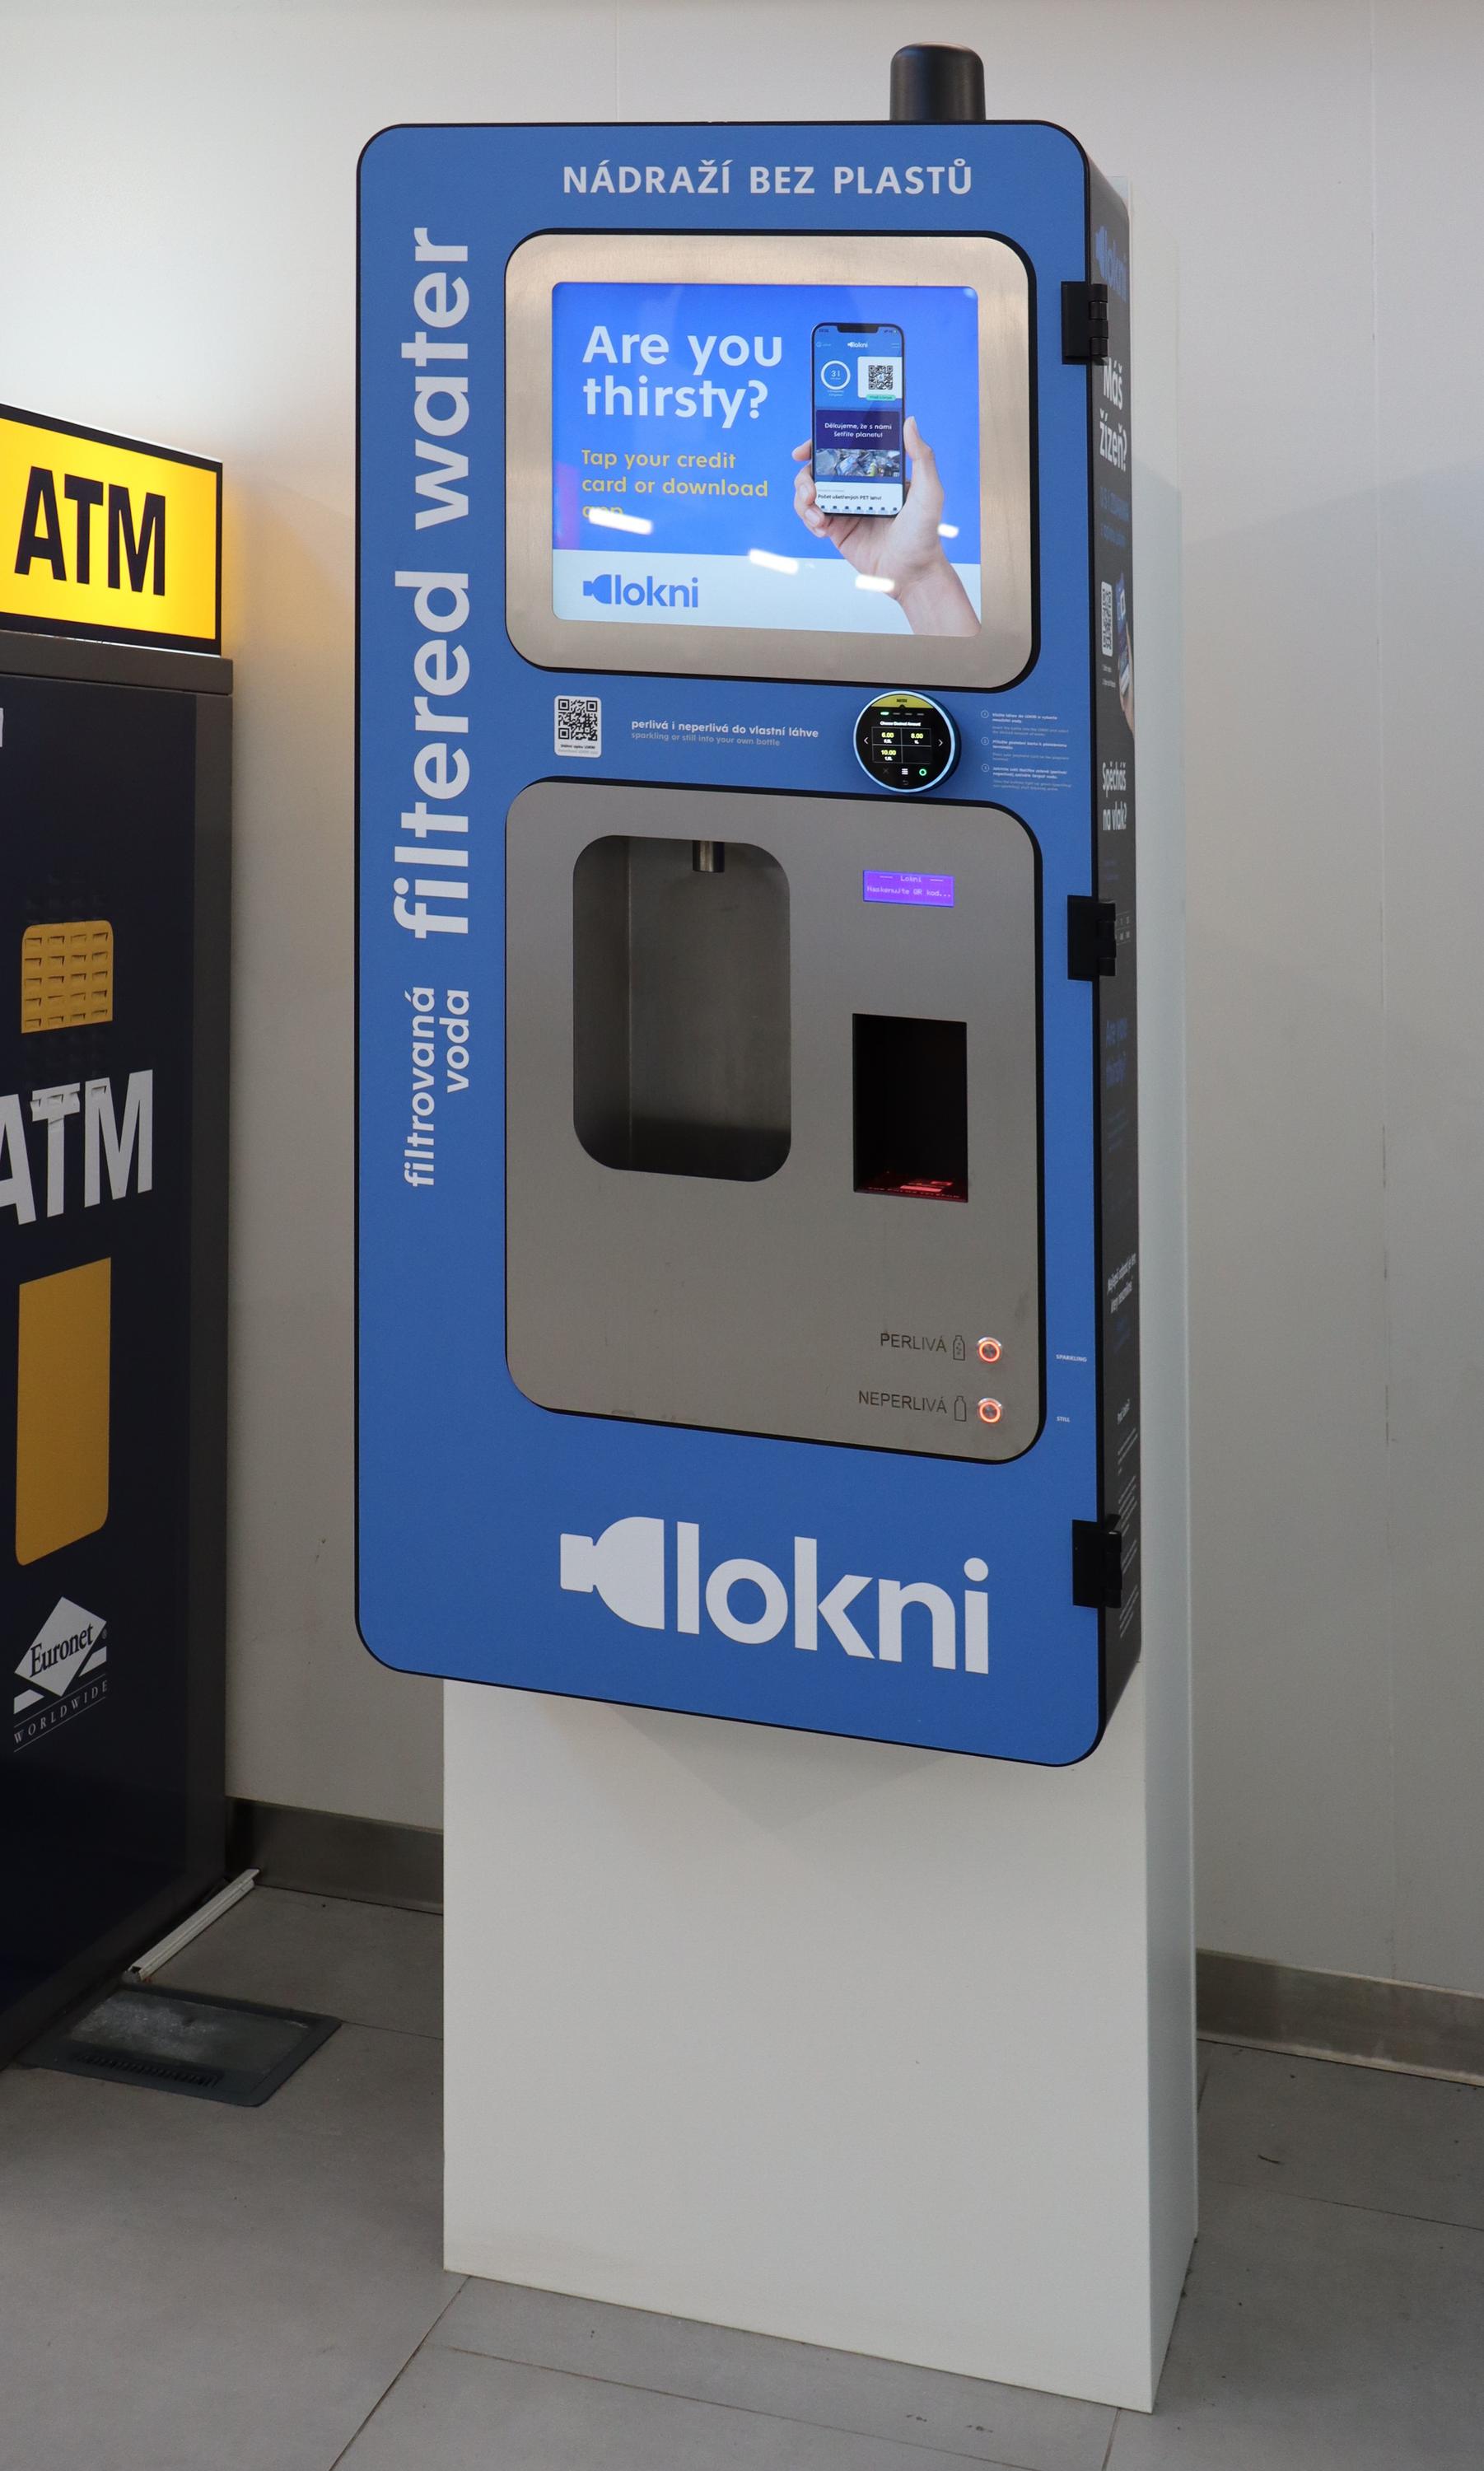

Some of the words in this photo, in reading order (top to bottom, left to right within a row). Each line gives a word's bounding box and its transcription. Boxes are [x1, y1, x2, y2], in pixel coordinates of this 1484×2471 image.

[563, 160, 731, 194] NÁDRAŽÍ
[750, 166, 815, 194] BEZ
[834, 158, 972, 195] PLASTŮ
[582, 325, 670, 365] Are
[687, 334, 782, 376] you
[401, 227, 470, 530] water
[582, 375, 768, 428] thirsty?
[1104, 357, 1123, 411] Máš
[581, 449, 618, 469] Tap
[624, 453, 670, 469] your
[677, 452, 736, 469] credit
[581, 476, 627, 493] card
[634, 480, 656, 493] or
[662, 478, 768, 497] download
[15, 465, 166, 596] ATM
[615, 574, 698, 608] lokni
[393, 570, 470, 940] filtered
[632, 720, 669, 731] perlivá
[671, 722, 675, 730] i
[679, 722, 729, 733] neperlivá
[732, 724, 746, 734] do
[749, 726, 786, 736] vlastní
[789, 726, 819, 738] láhve
[632, 731, 670, 741] sparkling
[682, 733, 697, 741] still
[716, 736, 735, 745] your
[756, 738, 781, 746] bottle
[439, 989, 470, 1093] voda
[404, 987, 435, 1187] filtrovaná
[0, 1069, 153, 1226] ATM
[880, 1333, 947, 1353] PERLIVÁ
[858, 1390, 948, 1414] NEPERLIVÁ
[677, 1520, 989, 1675] lokni
[30, 1622, 94, 1678] Euronet
[13, 1679, 108, 1745] WORLDWIDE
